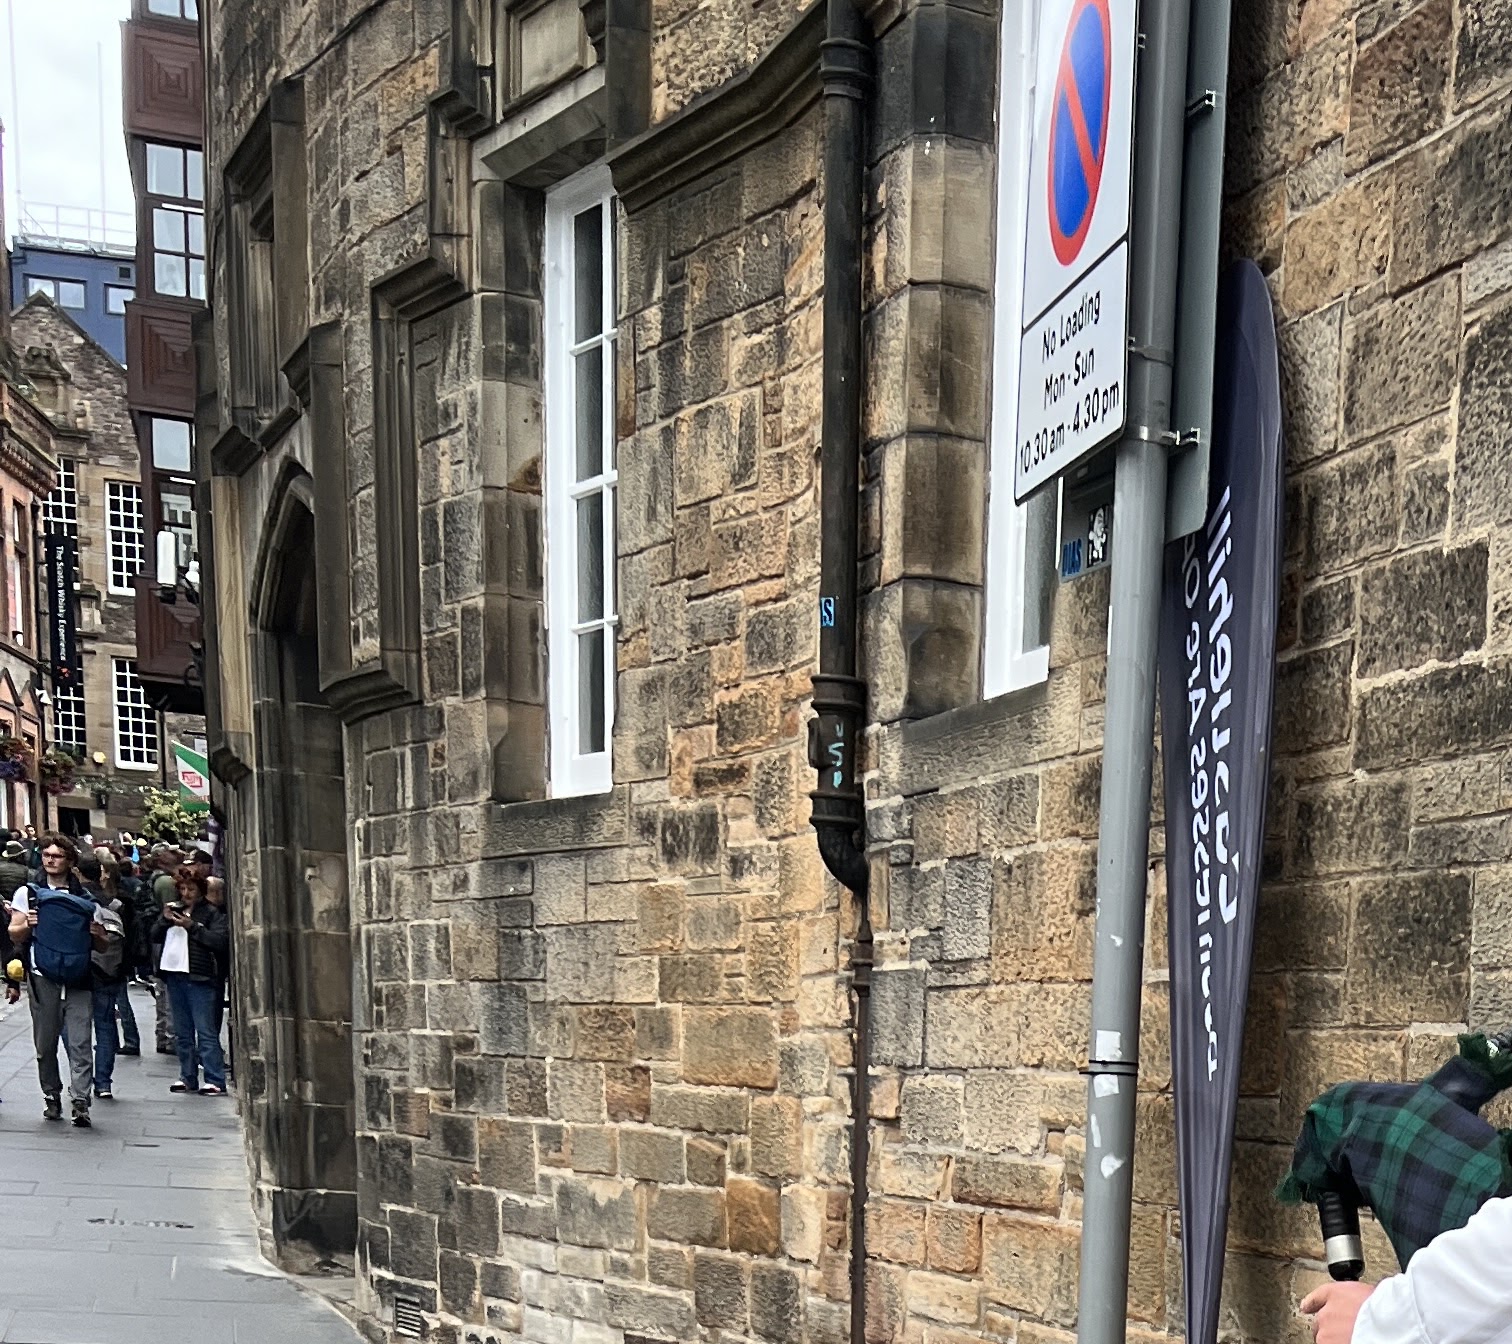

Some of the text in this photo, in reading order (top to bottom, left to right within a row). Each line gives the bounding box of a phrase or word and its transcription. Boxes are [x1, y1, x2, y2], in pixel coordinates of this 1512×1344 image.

[1042, 290, 1101, 363] No Loading
[1044, 372, 1065, 410] Mon
[1074, 348, 1095, 386] Sun
